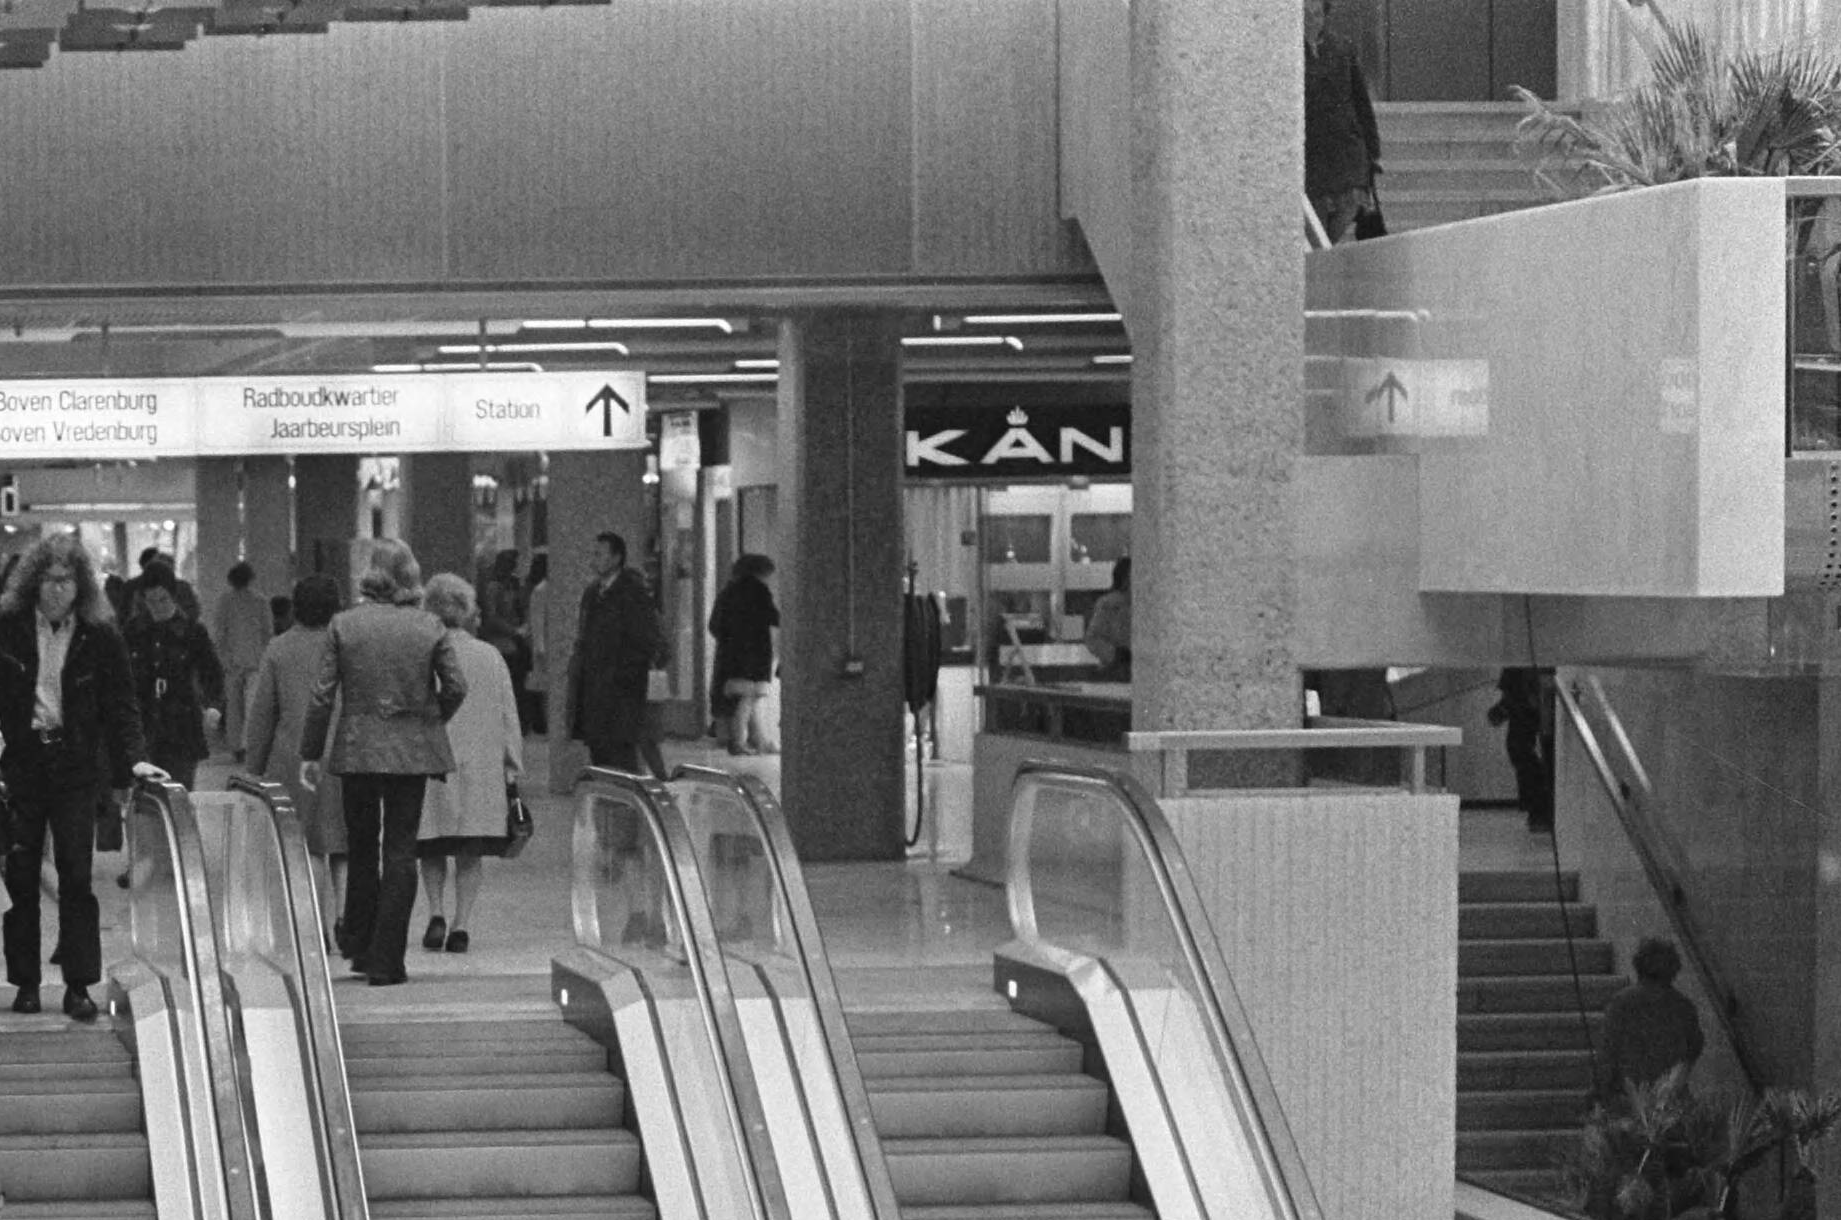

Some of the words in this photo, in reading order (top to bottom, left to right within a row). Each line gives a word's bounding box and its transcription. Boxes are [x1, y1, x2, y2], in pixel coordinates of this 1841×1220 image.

[58, 390, 157, 415] Clarenburg
[243, 386, 399, 408] Radboudkwartier
[475, 399, 541, 419] Station
[53, 421, 157, 446] Vredenburg
[270, 418, 401, 441] Jaarbeursplein
